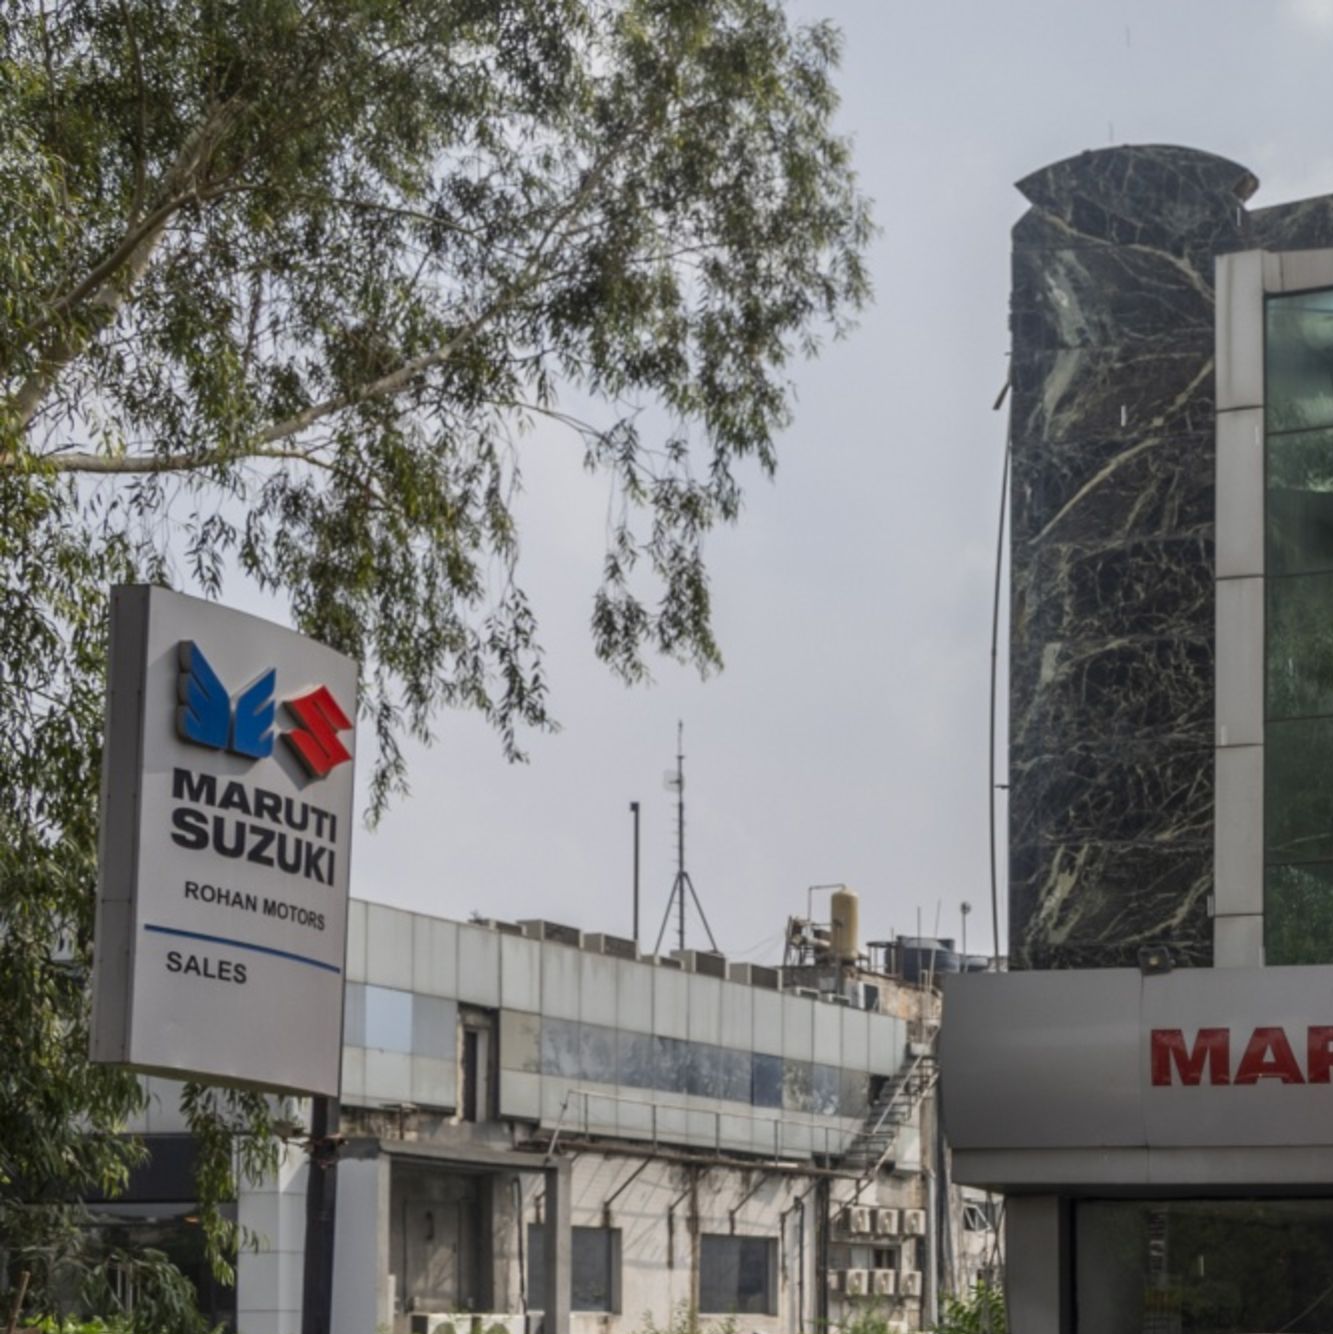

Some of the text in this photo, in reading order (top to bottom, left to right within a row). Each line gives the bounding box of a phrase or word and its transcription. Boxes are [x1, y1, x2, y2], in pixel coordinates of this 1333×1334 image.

[172, 767, 337, 844] MARUTI
[170, 807, 335, 887] SUZUKI
[184, 881, 326, 931] ROHAN MOTORS
[165, 951, 247, 984] SALES
